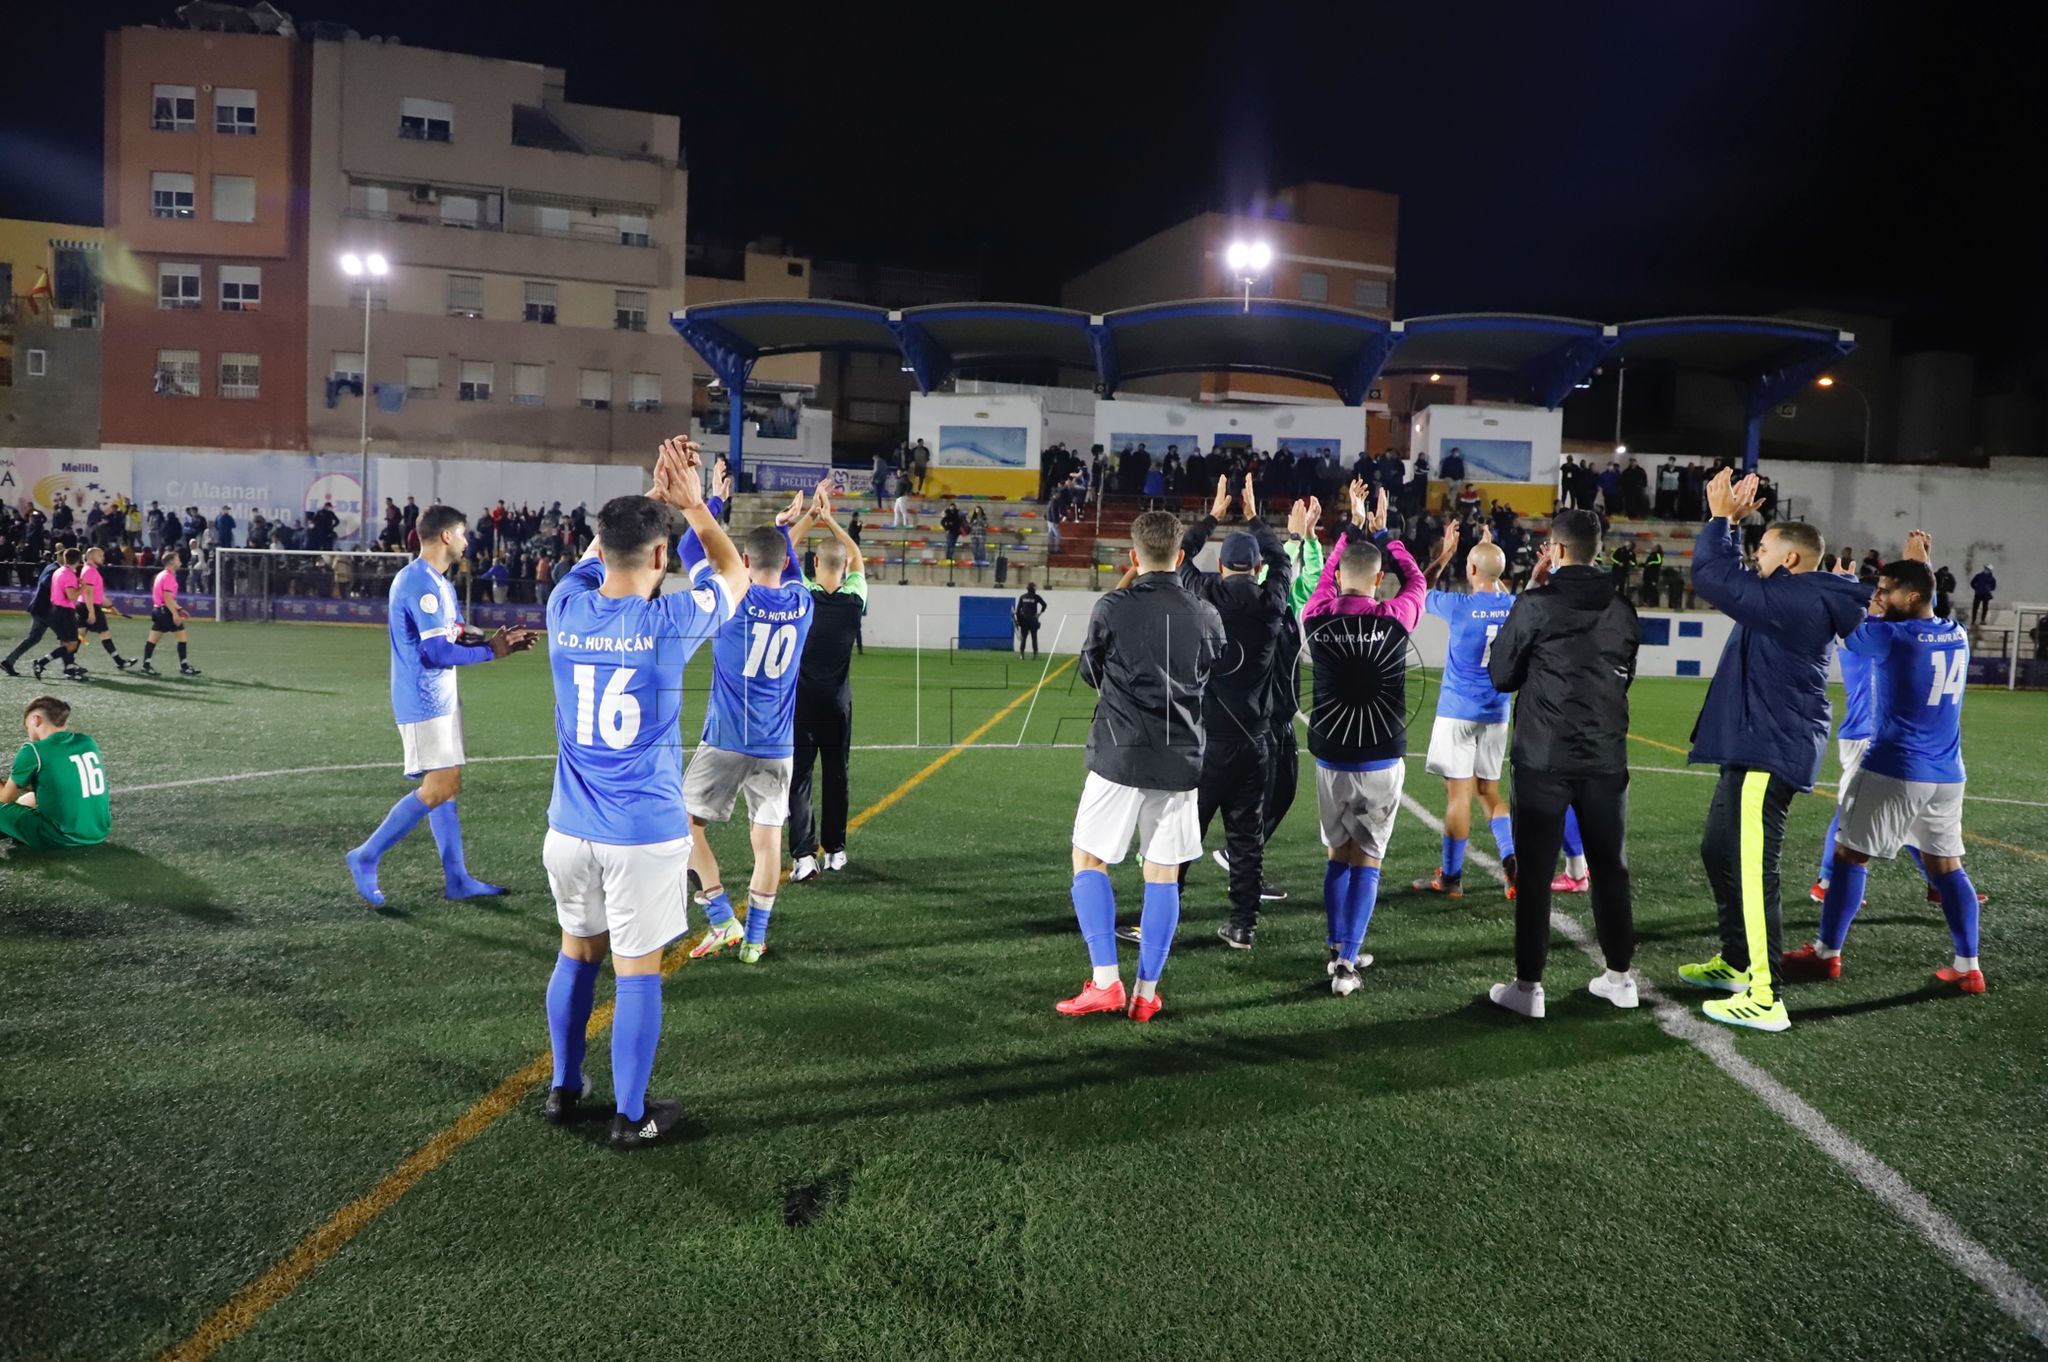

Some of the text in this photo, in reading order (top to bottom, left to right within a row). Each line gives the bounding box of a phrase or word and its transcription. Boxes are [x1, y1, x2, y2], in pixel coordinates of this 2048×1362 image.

[61, 462, 99, 473] Melilla
[166, 480, 269, 501] C/ Maanan
[748, 605, 767, 619] C.D.
[1471, 609, 1489, 619] C.D.
[557, 631, 654, 652] C.D. HURACÁN
[1313, 629, 1385, 644] C.D. HURACÁN
[1480, 624, 1505, 668] 1
[1917, 633, 1937, 643] C.D.
[742, 622, 798, 680] 10
[1927, 649, 1966, 706] 14
[573, 664, 641, 750] 16
[68, 751, 105, 799] 16
